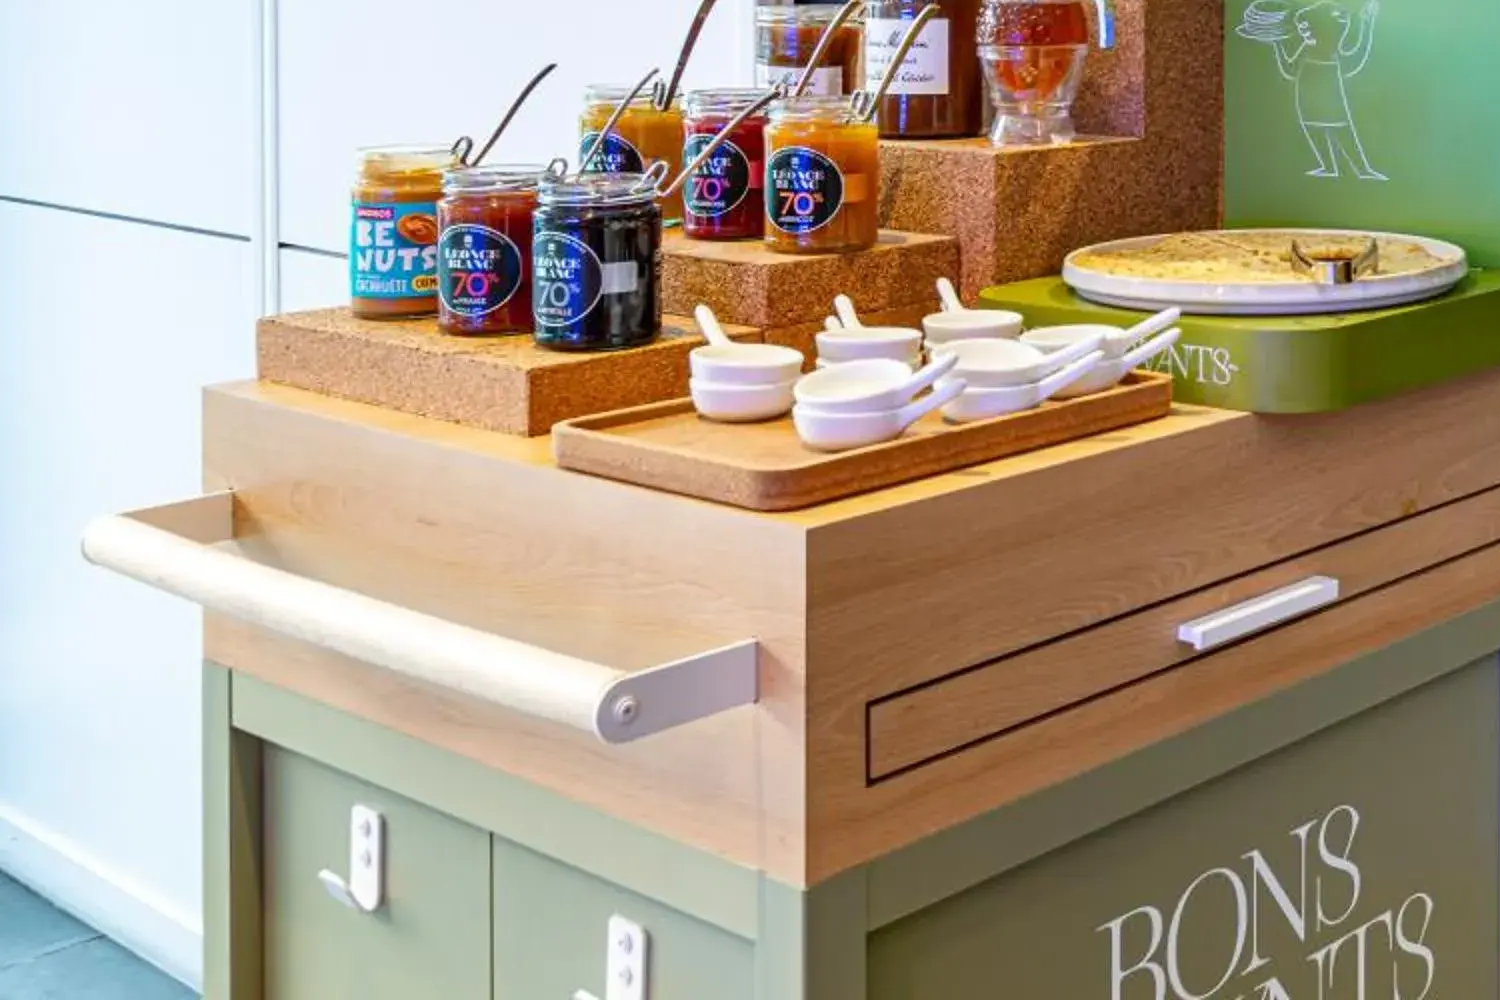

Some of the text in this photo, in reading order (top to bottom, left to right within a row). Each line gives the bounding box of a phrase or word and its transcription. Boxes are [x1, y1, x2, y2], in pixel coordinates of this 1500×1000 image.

[356, 219, 395, 247] BE
[355, 246, 437, 273] NUTS
[1095, 803, 1364, 1000] BONS
